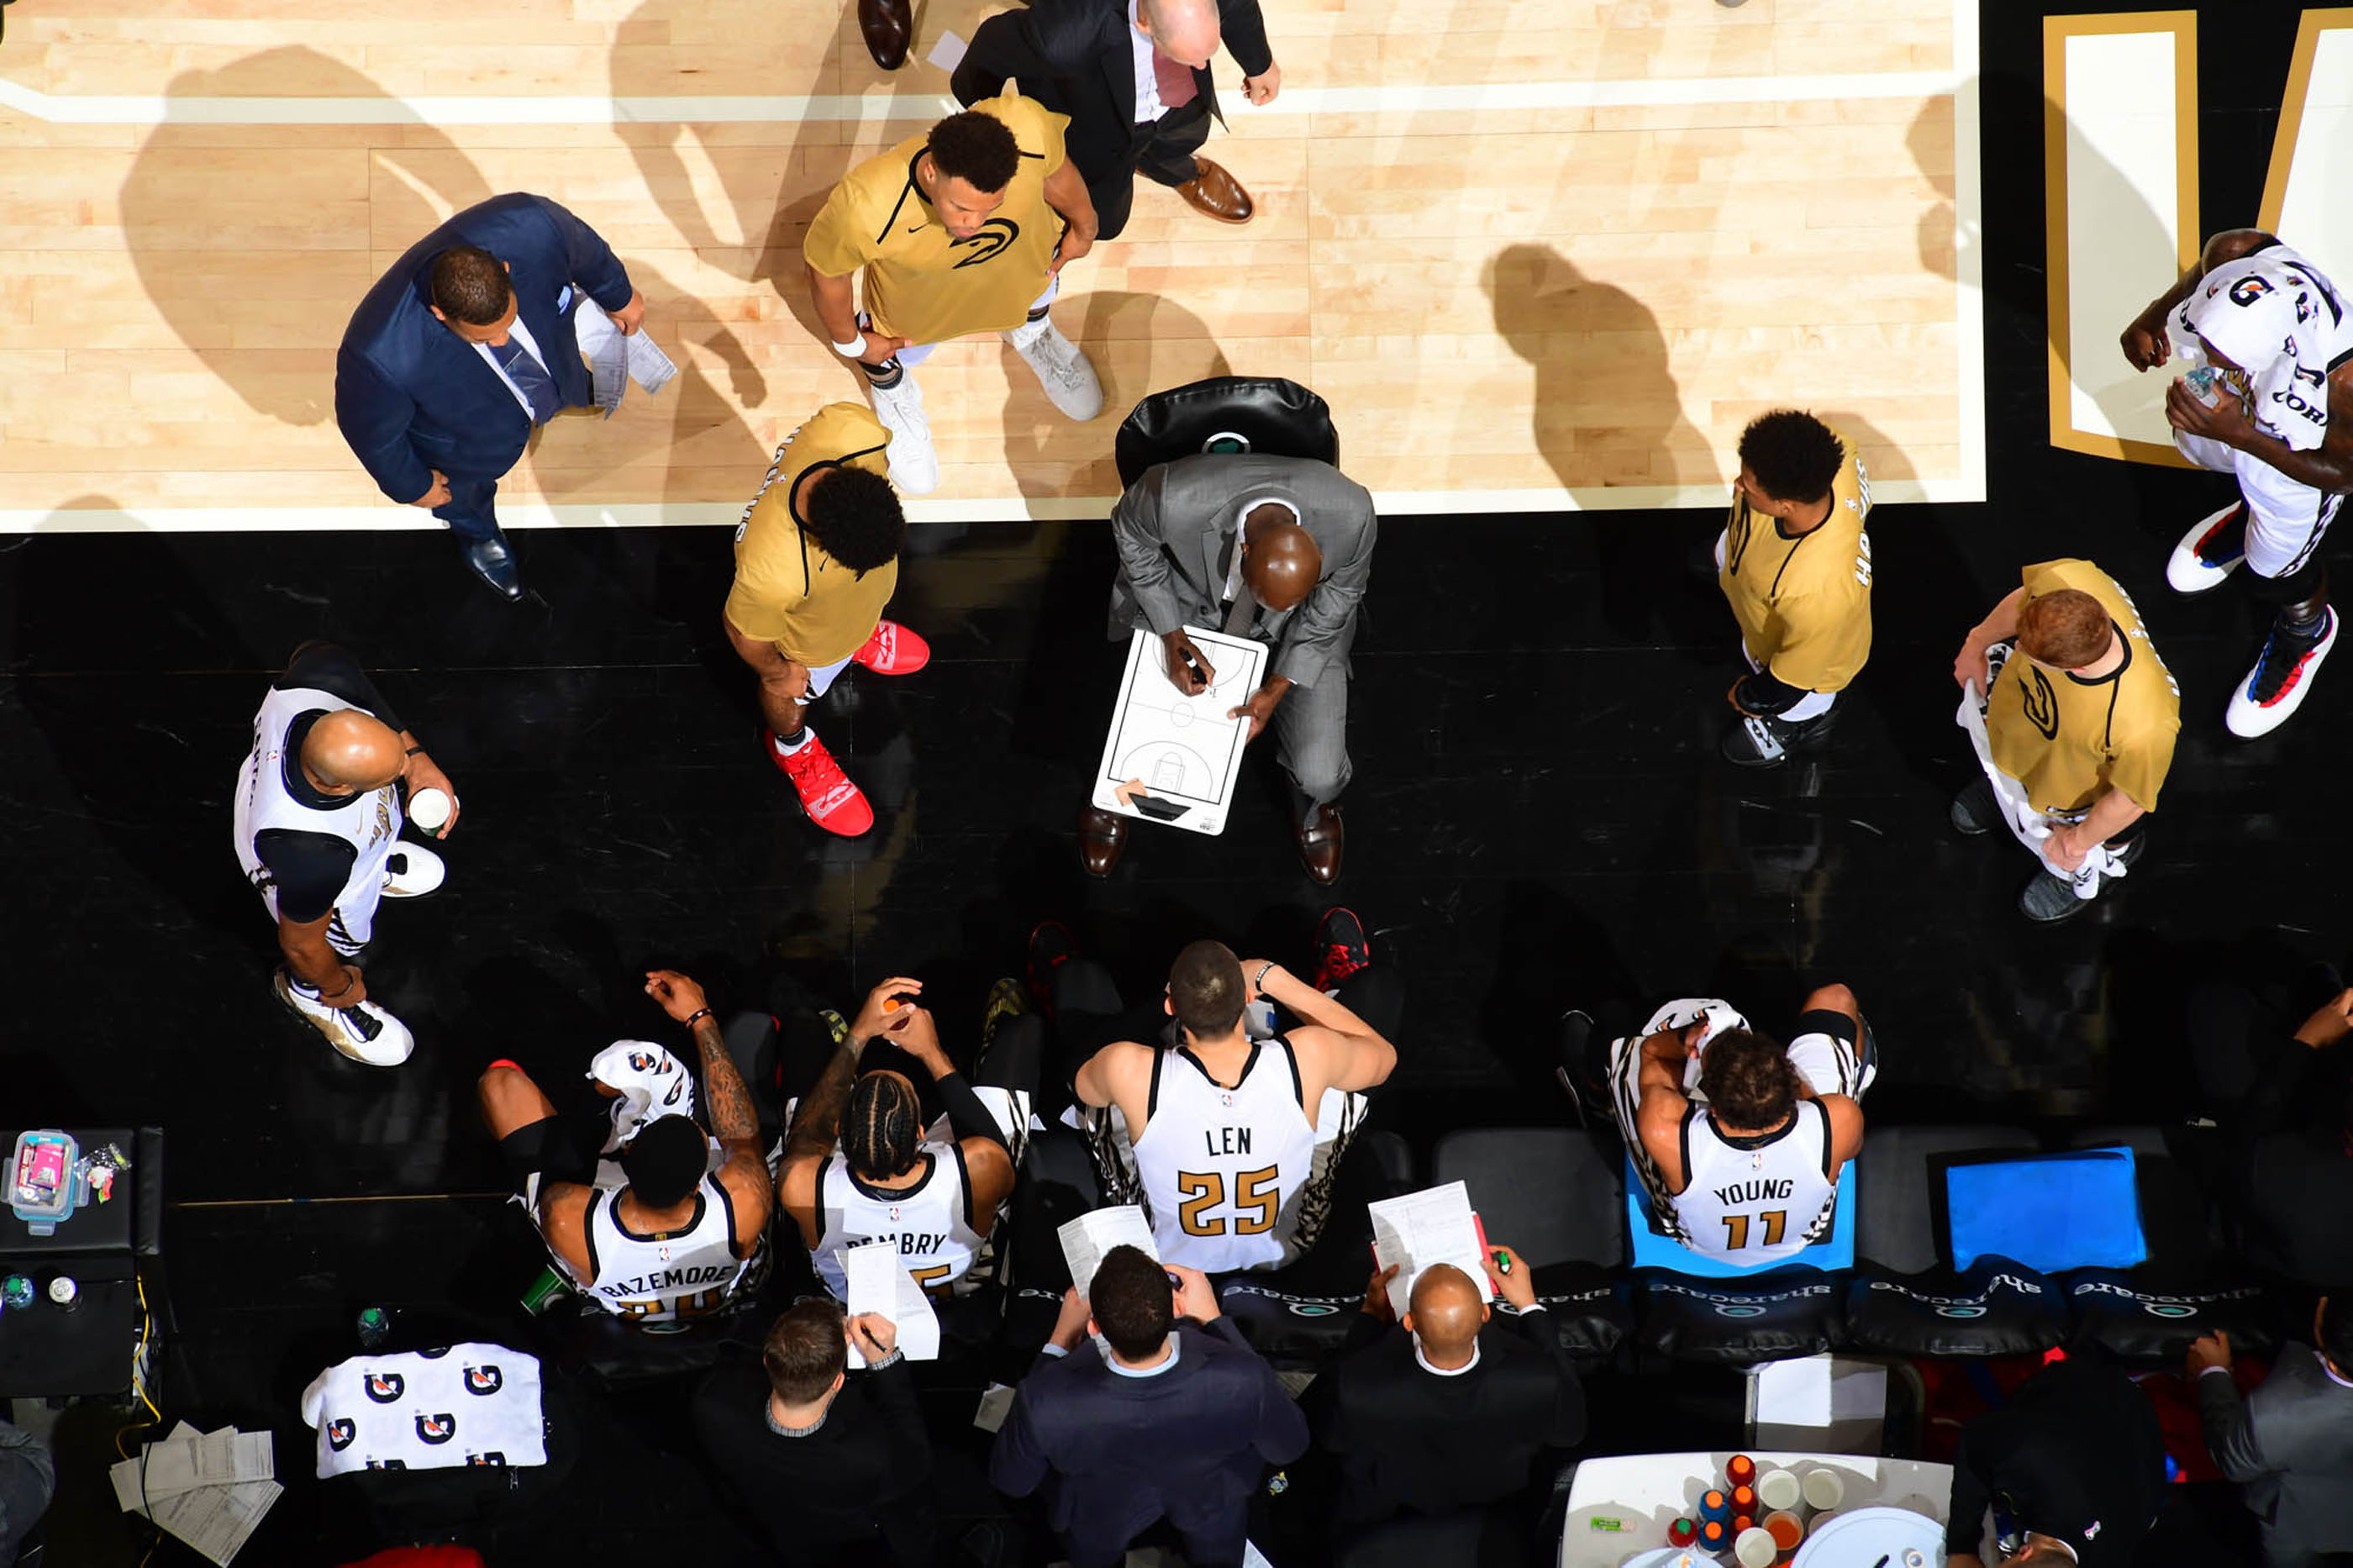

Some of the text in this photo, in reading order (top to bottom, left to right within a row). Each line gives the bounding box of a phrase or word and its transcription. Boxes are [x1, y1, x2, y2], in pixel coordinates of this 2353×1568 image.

[1206, 1127, 1251, 1156] LEN
[1177, 1164, 1280, 1237] 25
[1713, 1179, 1794, 1207] YOUNG
[1722, 1210, 1787, 1251] 11
[600, 1265, 734, 1297] BAZEMORE
[1650, 1283, 1831, 1303] sharecare
[1870, 1274, 2042, 1305] sharecare
